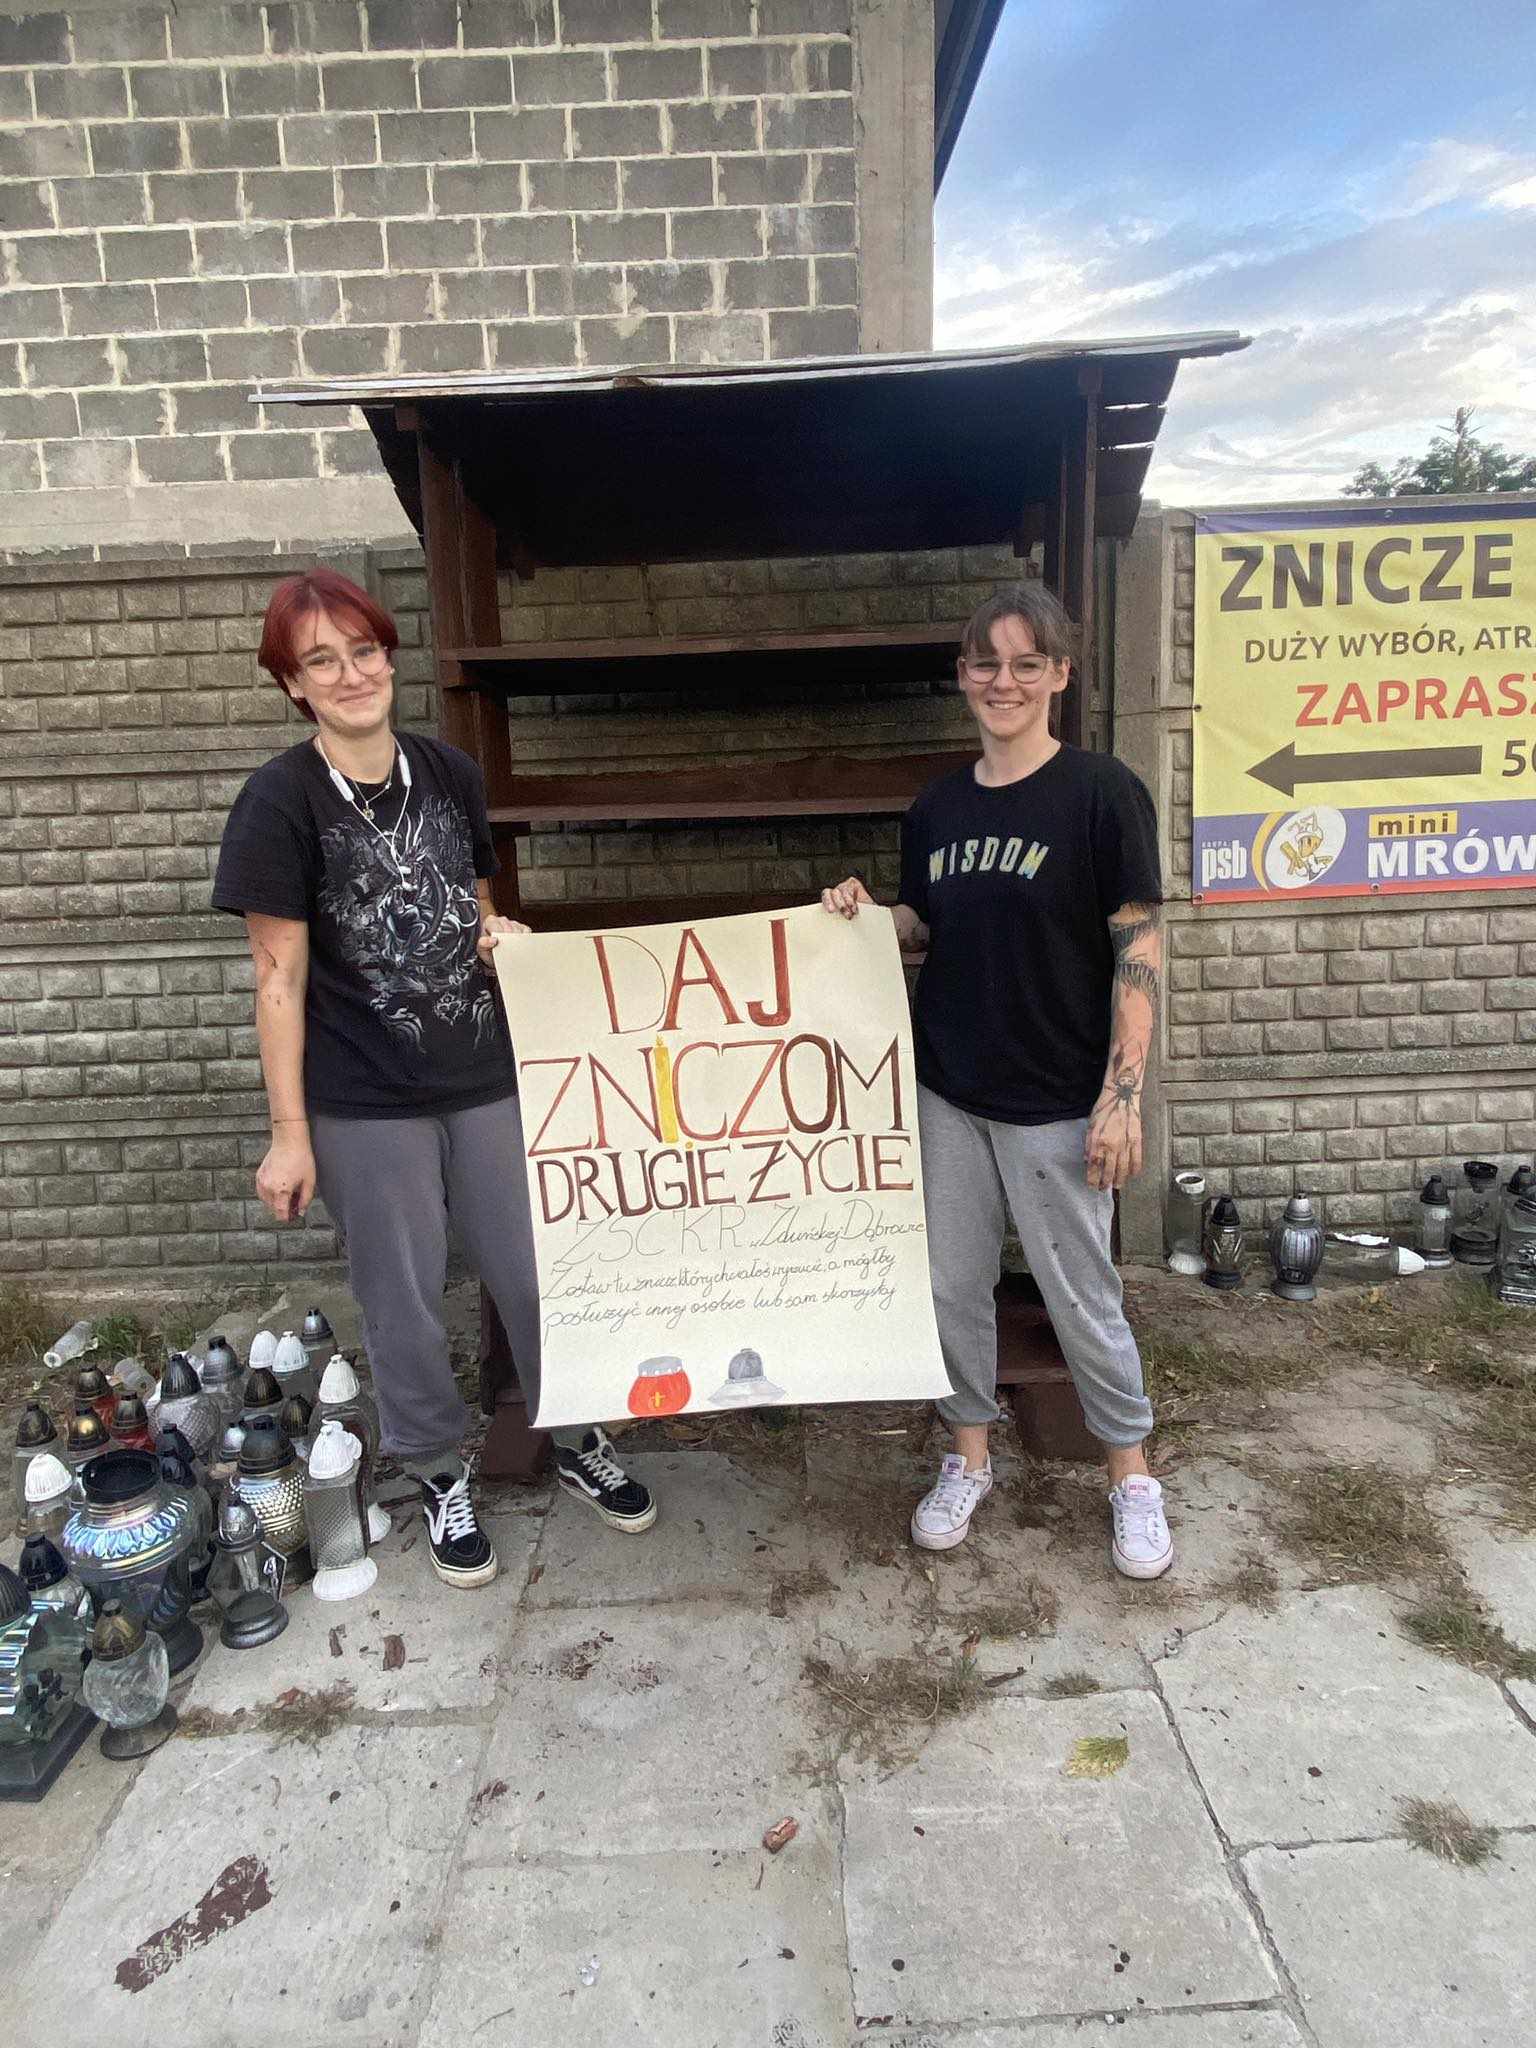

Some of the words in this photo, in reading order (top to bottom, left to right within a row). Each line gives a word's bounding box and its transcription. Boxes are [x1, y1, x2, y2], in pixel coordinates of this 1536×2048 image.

[1220, 533, 1514, 612] ZNICZE
[1245, 630, 1329, 663] DUŻY
[1339, 623, 1465, 657] WYBÓR,
[1473, 625, 1536, 651] ATR
[1296, 673, 1536, 727] ZAPRAS
[1377, 812, 1448, 836] mini
[929, 836, 1050, 883] WISDOM
[1201, 840, 1248, 888] psb
[585, 917, 793, 1034] DAJ
